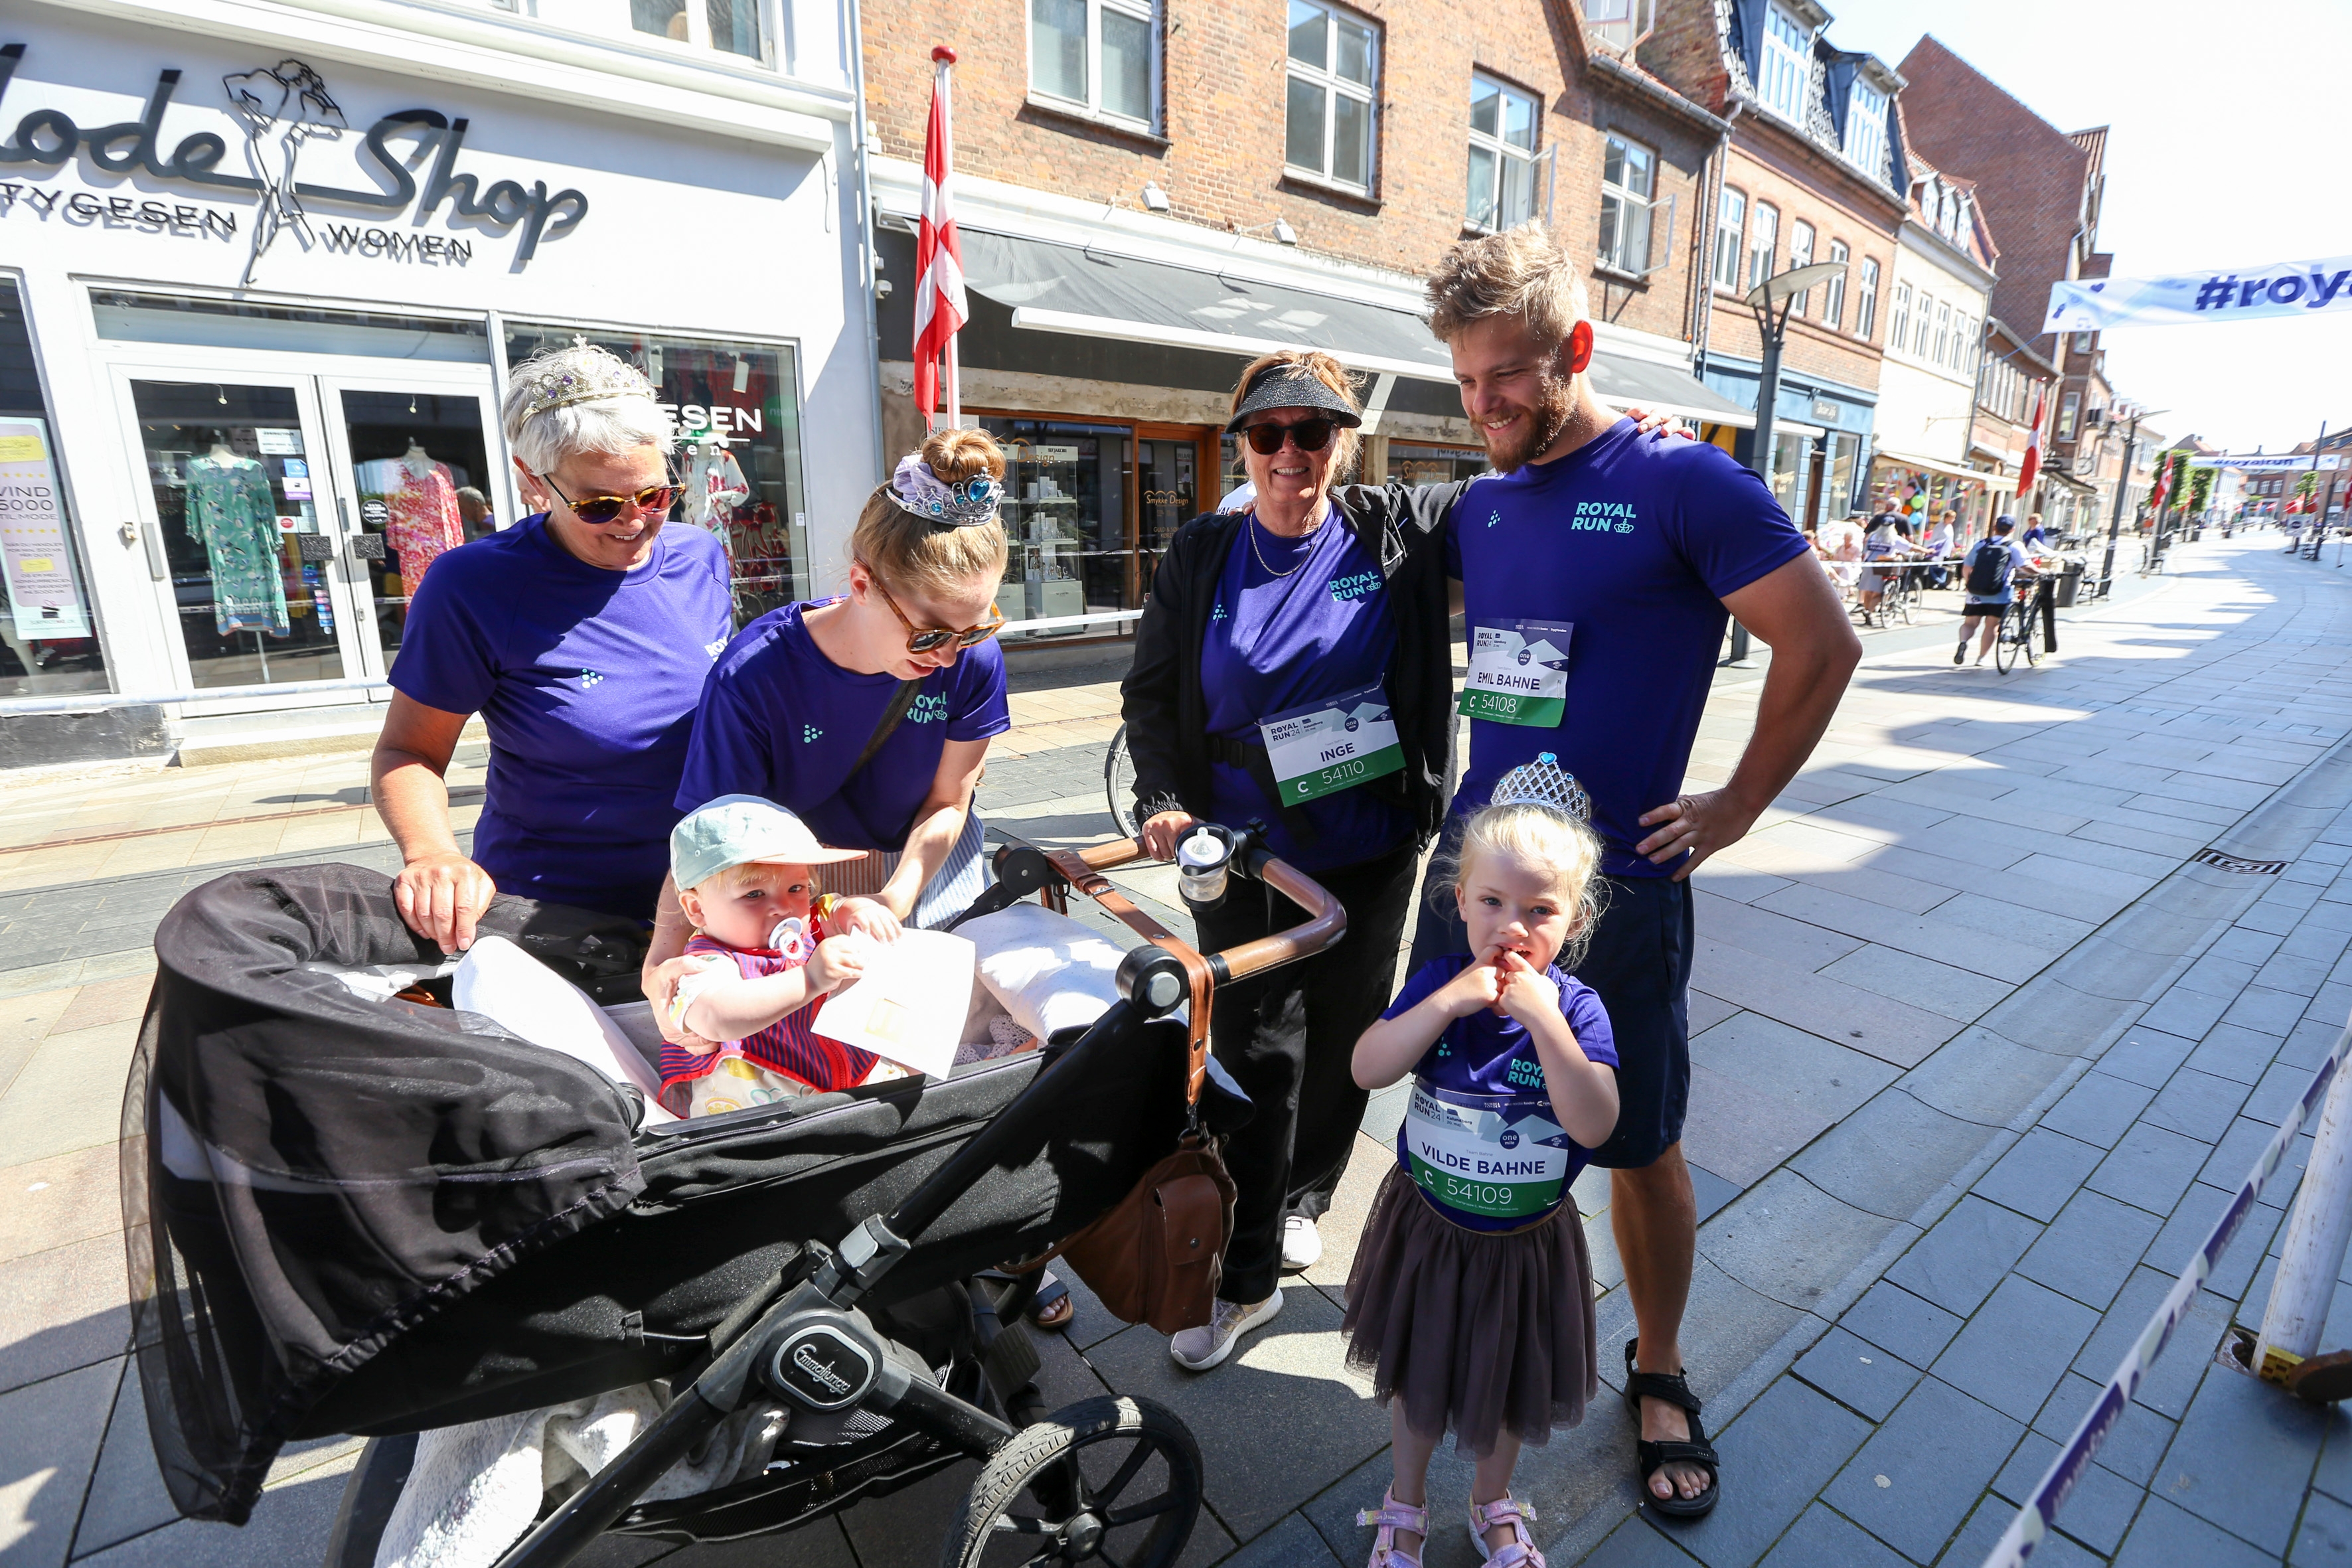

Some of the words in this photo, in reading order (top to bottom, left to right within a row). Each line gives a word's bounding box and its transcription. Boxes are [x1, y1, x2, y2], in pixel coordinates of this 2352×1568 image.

[0, 44, 263, 189] ode
[296, 110, 588, 260] Shop
[328, 224, 472, 258] WOMEN
[2195, 270, 2352, 310] #roy
[1017, 446, 1055, 467] Design
[1146, 495, 1168, 506] Smykke
[1169, 495, 1188, 505] Design
[1575, 502, 1636, 518] ROYAL
[1571, 516, 1612, 532] RUN
[1328, 571, 1379, 591] ROYAL
[1332, 585, 1366, 602] RUN
[1477, 672, 1494, 684] EMIL
[1496, 674, 1540, 690] BAHNE
[913, 691, 947, 710] OYAL
[1469, 696, 1476, 708] C
[1481, 694, 1517, 714] 54108
[1271, 722, 1298, 735] ROYAL
[1320, 743, 1355, 762] INGE
[1297, 781, 1309, 793] C
[1322, 761, 1364, 784] 54110
[1511, 1059, 1544, 1077] ROY
[1508, 1071, 1540, 1088] RUN
[1415, 1093, 1441, 1113] ROYAL
[1447, 1116, 1472, 1125] Kalundborg
[1422, 1142, 1470, 1172] VILDE
[1477, 1160, 1545, 1175] BAHNE
[1425, 1170, 1433, 1185] C
[1447, 1178, 1512, 1204] 54109
[793, 1343, 851, 1394] Emmaljunga
